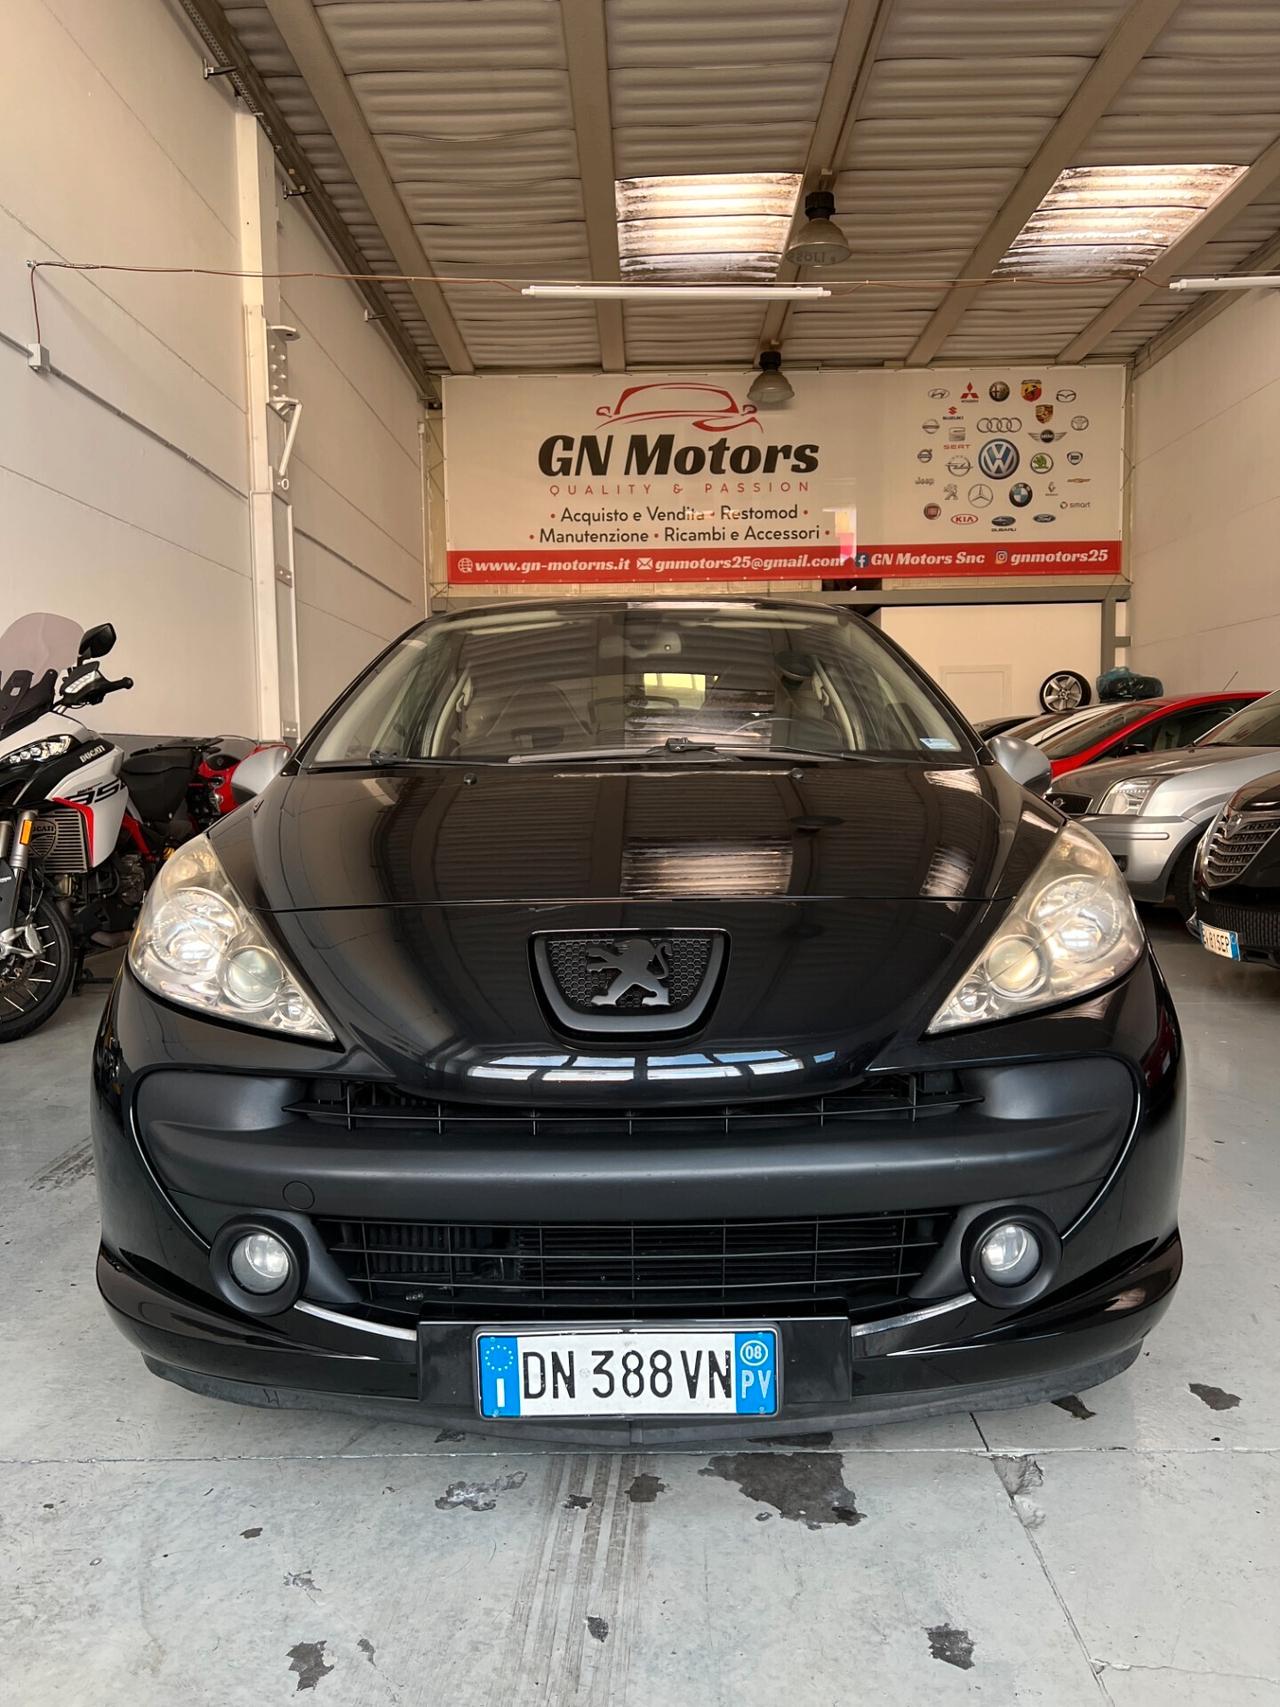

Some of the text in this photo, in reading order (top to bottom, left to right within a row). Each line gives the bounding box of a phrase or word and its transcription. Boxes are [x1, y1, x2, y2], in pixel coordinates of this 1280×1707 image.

[538, 434, 820, 476] GN Motors
[549, 481, 809, 497] QUALITY & PASSION
[1069, 501, 1091, 509] smart
[560, 503, 798, 526] Acquisto e Vendita Restomod
[539, 525, 820, 543] Manutenzione Ricambi e Accessori
[475, 558, 631, 574] www.gn-motorns.it
[654, 554, 845, 573] gnmotors25@gmail.com
[871, 551, 986, 566] GN Motors Snc
[1010, 549, 1109, 566] gnmotors25
[79, 744, 106, 763] DUCATI
[744, 1344, 763, 1360] 08
[522, 1350, 575, 1399] DN
[741, 1369, 772, 1399] PV
